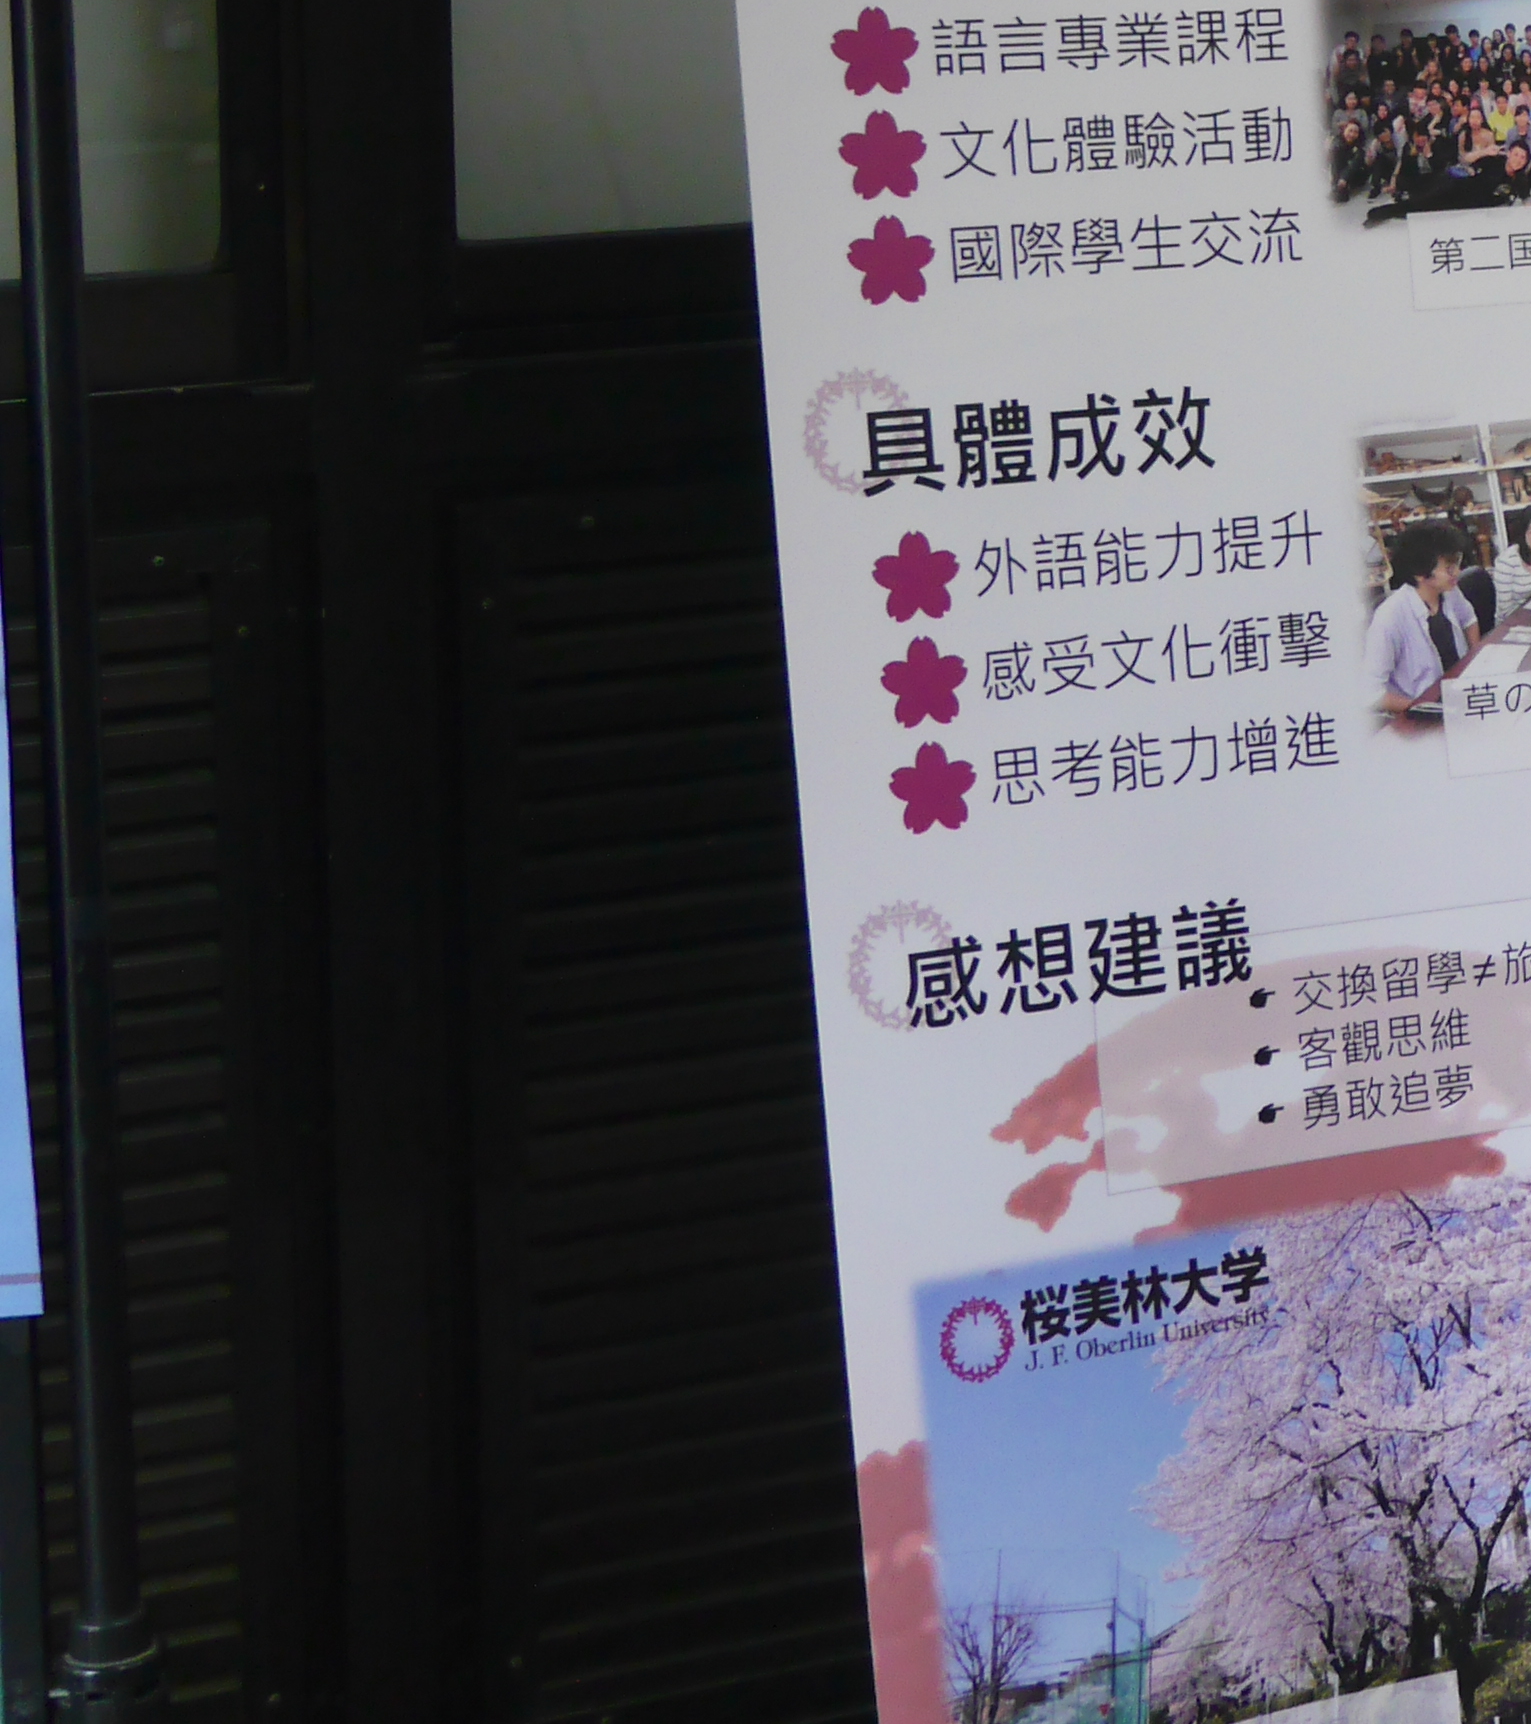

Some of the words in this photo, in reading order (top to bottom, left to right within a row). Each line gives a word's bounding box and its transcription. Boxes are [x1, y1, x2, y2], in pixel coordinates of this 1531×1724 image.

[932, 7, 1289, 76] 語言專業課程
[940, 106, 1292, 179] 文化體驗活動
[949, 207, 1303, 284] 國際學生交流
[863, 385, 1217, 497] 具體成效
[974, 509, 1323, 598] 外語能力提升
[982, 611, 1331, 701] 感受文化衝擊
[992, 711, 1340, 805] 思考能力增進
[905, 898, 1253, 1029] 感想建議
[1298, 1007, 1472, 1072] 客觀思維
[1303, 1065, 1475, 1130] 勇敢追夢
[1020, 1246, 1271, 1346] 桜美林大学
[1076, 1329, 1157, 1361] Oberlin
[1162, 1306, 1272, 1347] University
